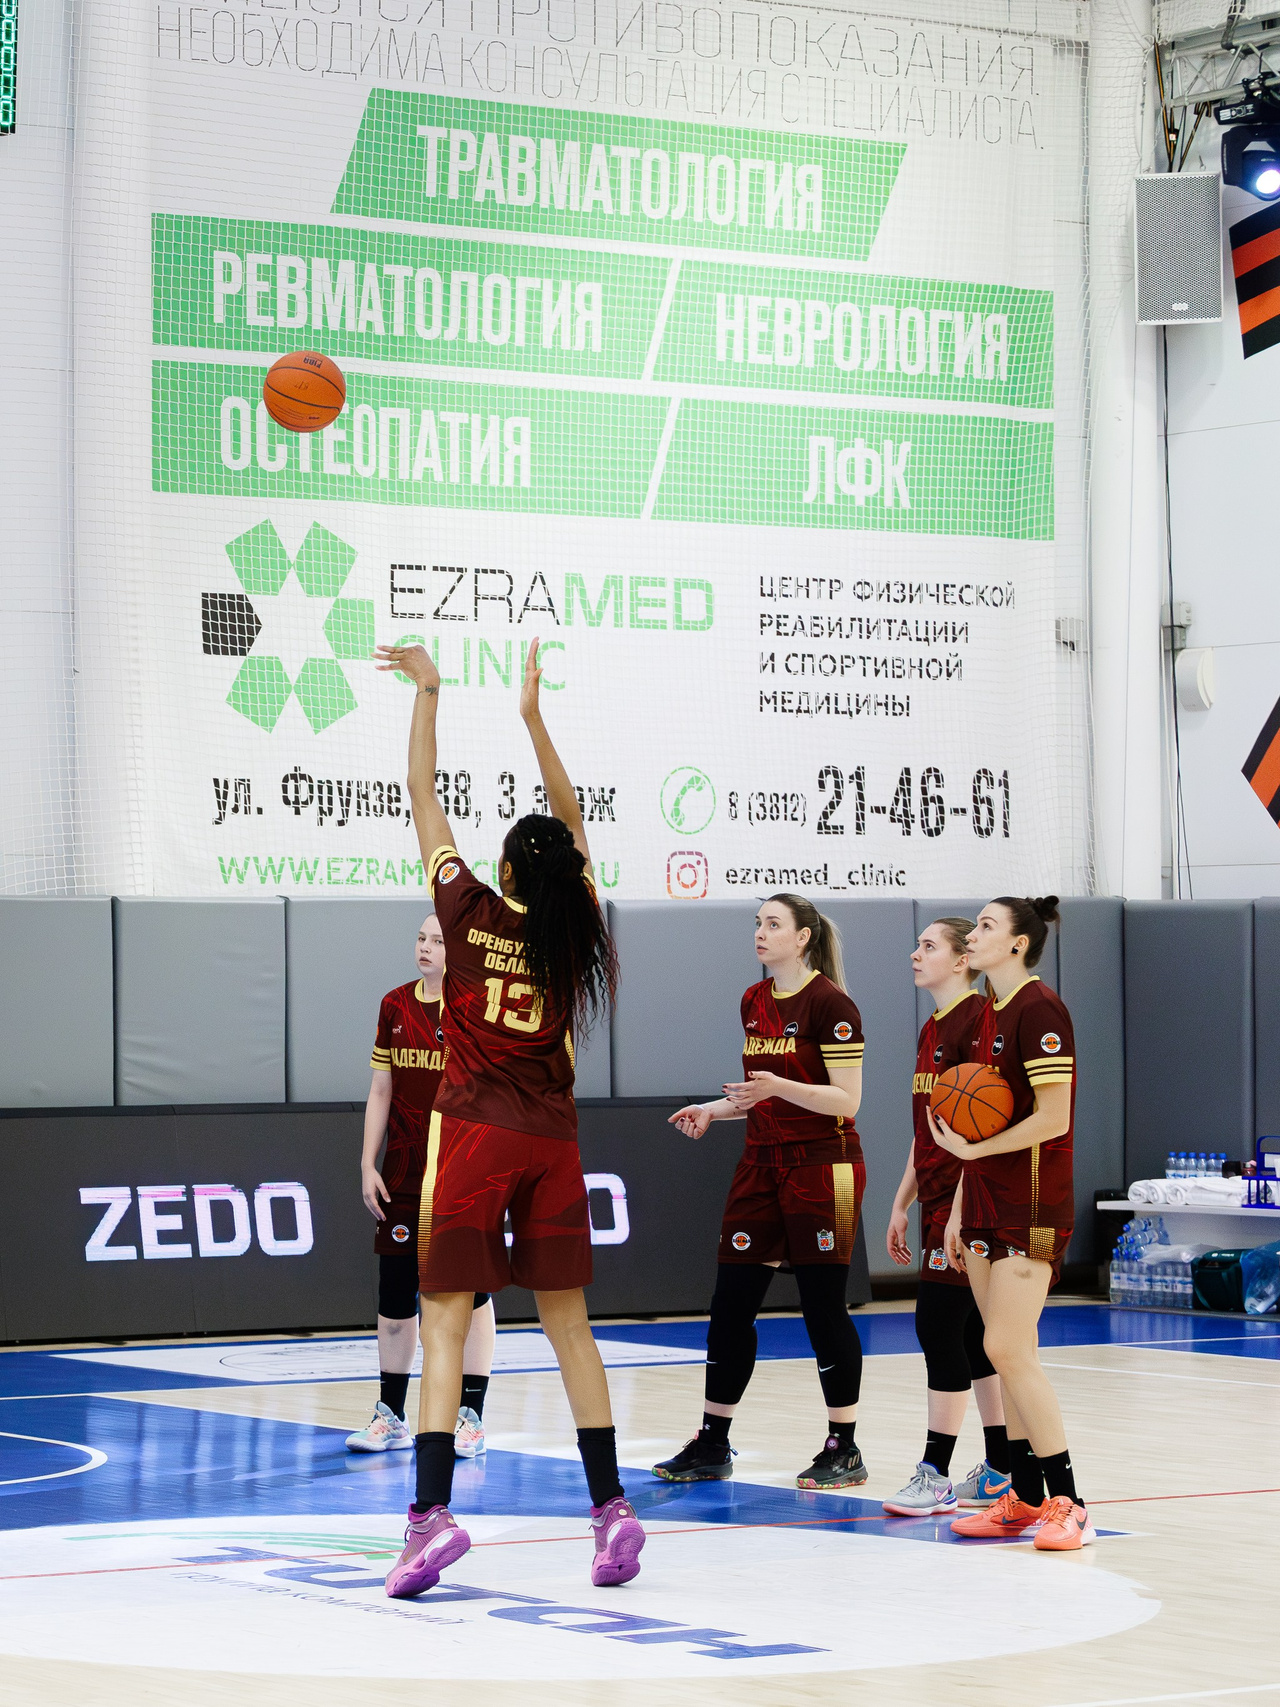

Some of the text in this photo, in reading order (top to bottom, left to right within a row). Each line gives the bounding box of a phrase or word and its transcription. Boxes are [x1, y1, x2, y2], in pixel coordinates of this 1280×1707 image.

[156, 5, 1044, 150] НЕОБХОДИМА КОНСУЛЬТАЦИЯ СПЕЦИАЛИСТА.
[417, 125, 822, 233] ТРАВМАТОЛОГИЯ
[213, 250, 602, 353] РЕВМАТОЛОГИЯ
[717, 291, 1008, 382] НЕВРОЛОГИЯ
[803, 434, 912, 510] ЛФК
[389, 563, 716, 632] EZRAMED
[759, 575, 1016, 609] ЦЕНТР ФИЗИЧЕСКОЙ
[759, 613, 970, 646] РЕАБИЛИТАЦИИ
[759, 651, 963, 681] И СПОРТИВНОЙ
[759, 690, 911, 719] МЕДИЦИНЫ
[211, 777, 264, 826] ул.
[281, 766, 412, 828] Фрунзе,
[497, 771, 516, 821] 3
[728, 764, 1011, 839] 8 (3812) 21-46-61
[724, 862, 908, 891] ezramed_clinic
[483, 977, 544, 1034] 13
[742, 1036, 797, 1057] АДЕЖДА
[78, 1181, 316, 1262] ZEDO
